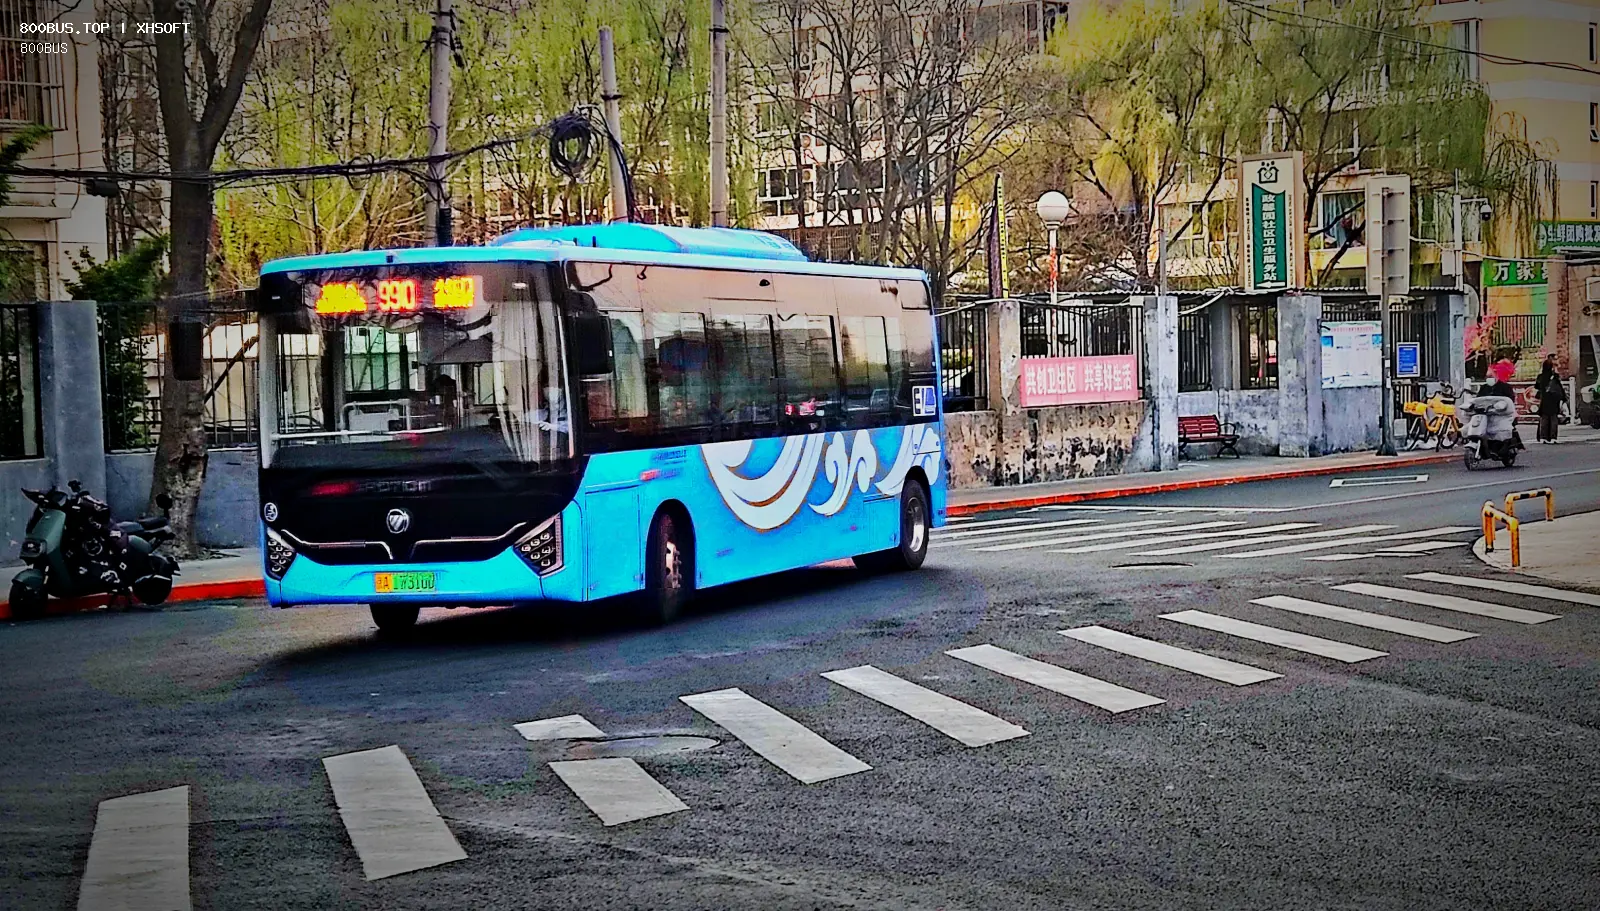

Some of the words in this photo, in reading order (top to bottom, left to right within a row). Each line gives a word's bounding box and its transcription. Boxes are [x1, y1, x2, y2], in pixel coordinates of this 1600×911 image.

[378, 279, 417, 311] 990
[1025, 364, 1077, 395] 共创卫生区
[1084, 361, 1132, 392] 共享好生活
